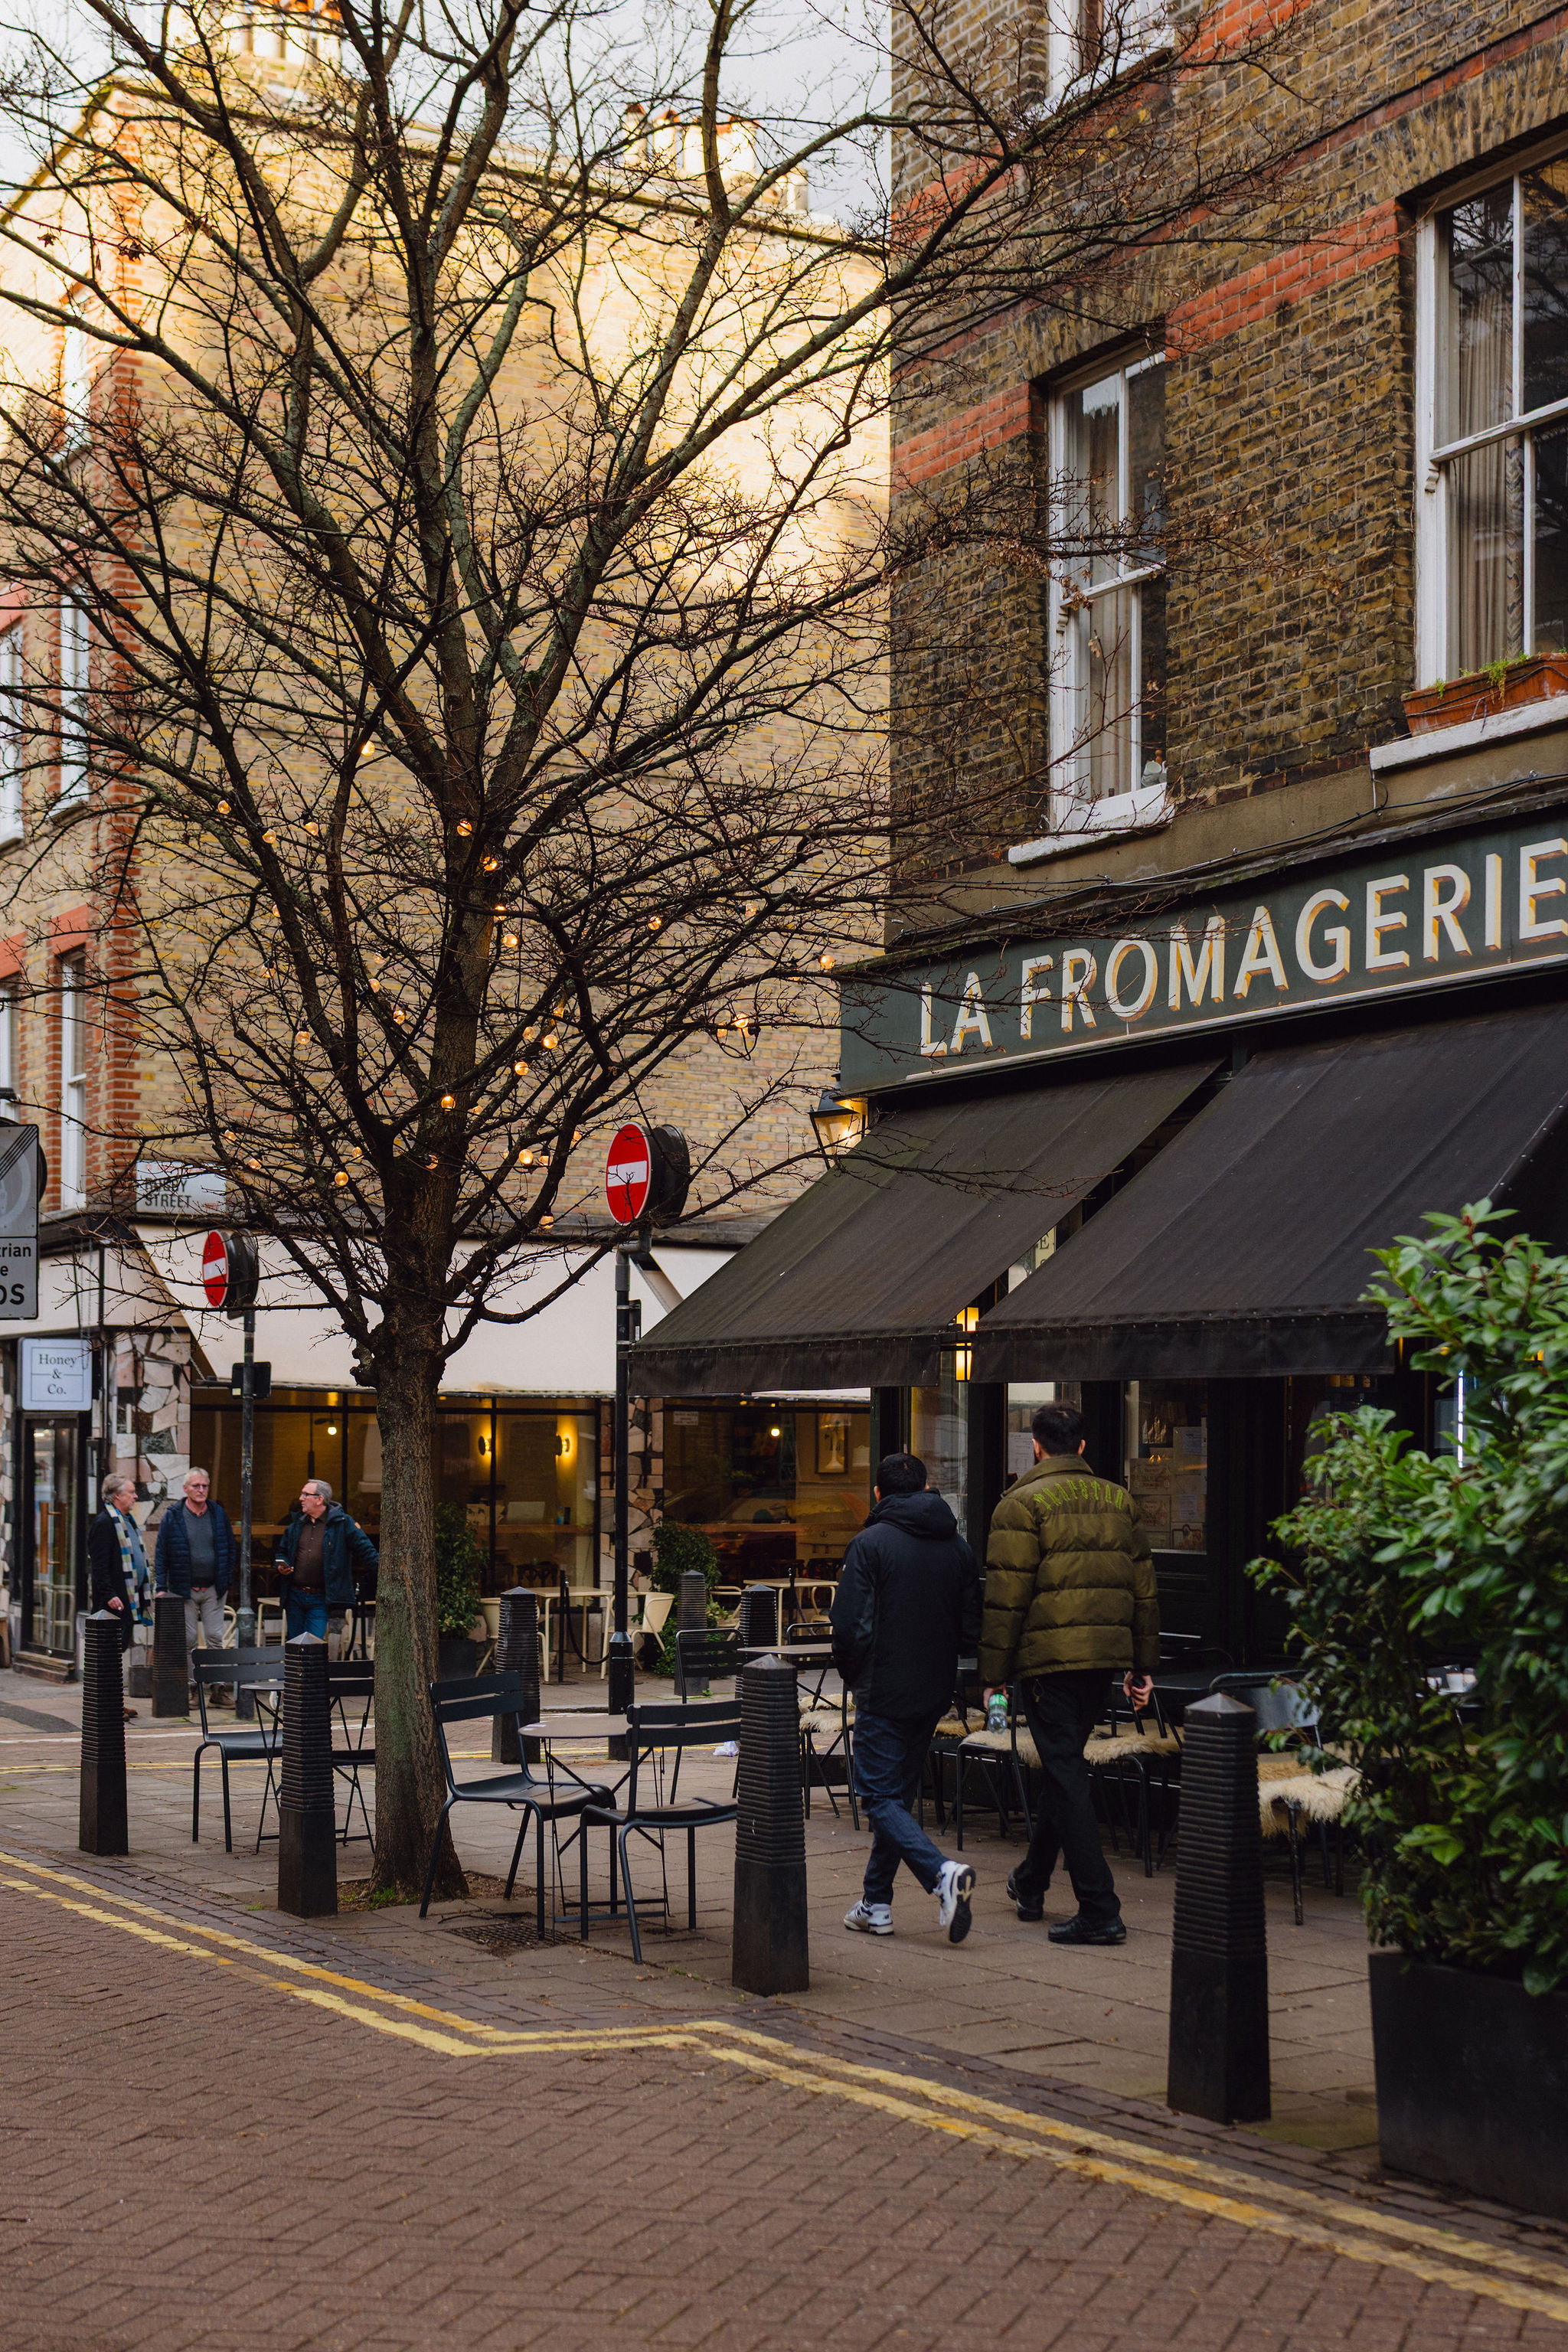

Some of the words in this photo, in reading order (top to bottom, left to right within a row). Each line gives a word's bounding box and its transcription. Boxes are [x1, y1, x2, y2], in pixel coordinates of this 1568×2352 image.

[921, 972, 993, 1057] LA
[1021, 838, 1568, 1040] FROMAGERIE
[145, 1194, 191, 1207] STREET
[0, 1243, 31, 1257] rian
[39, 1354, 77, 1368] Honey
[52, 1368, 62, 1379] &
[47, 1383, 67, 1394] Co.
